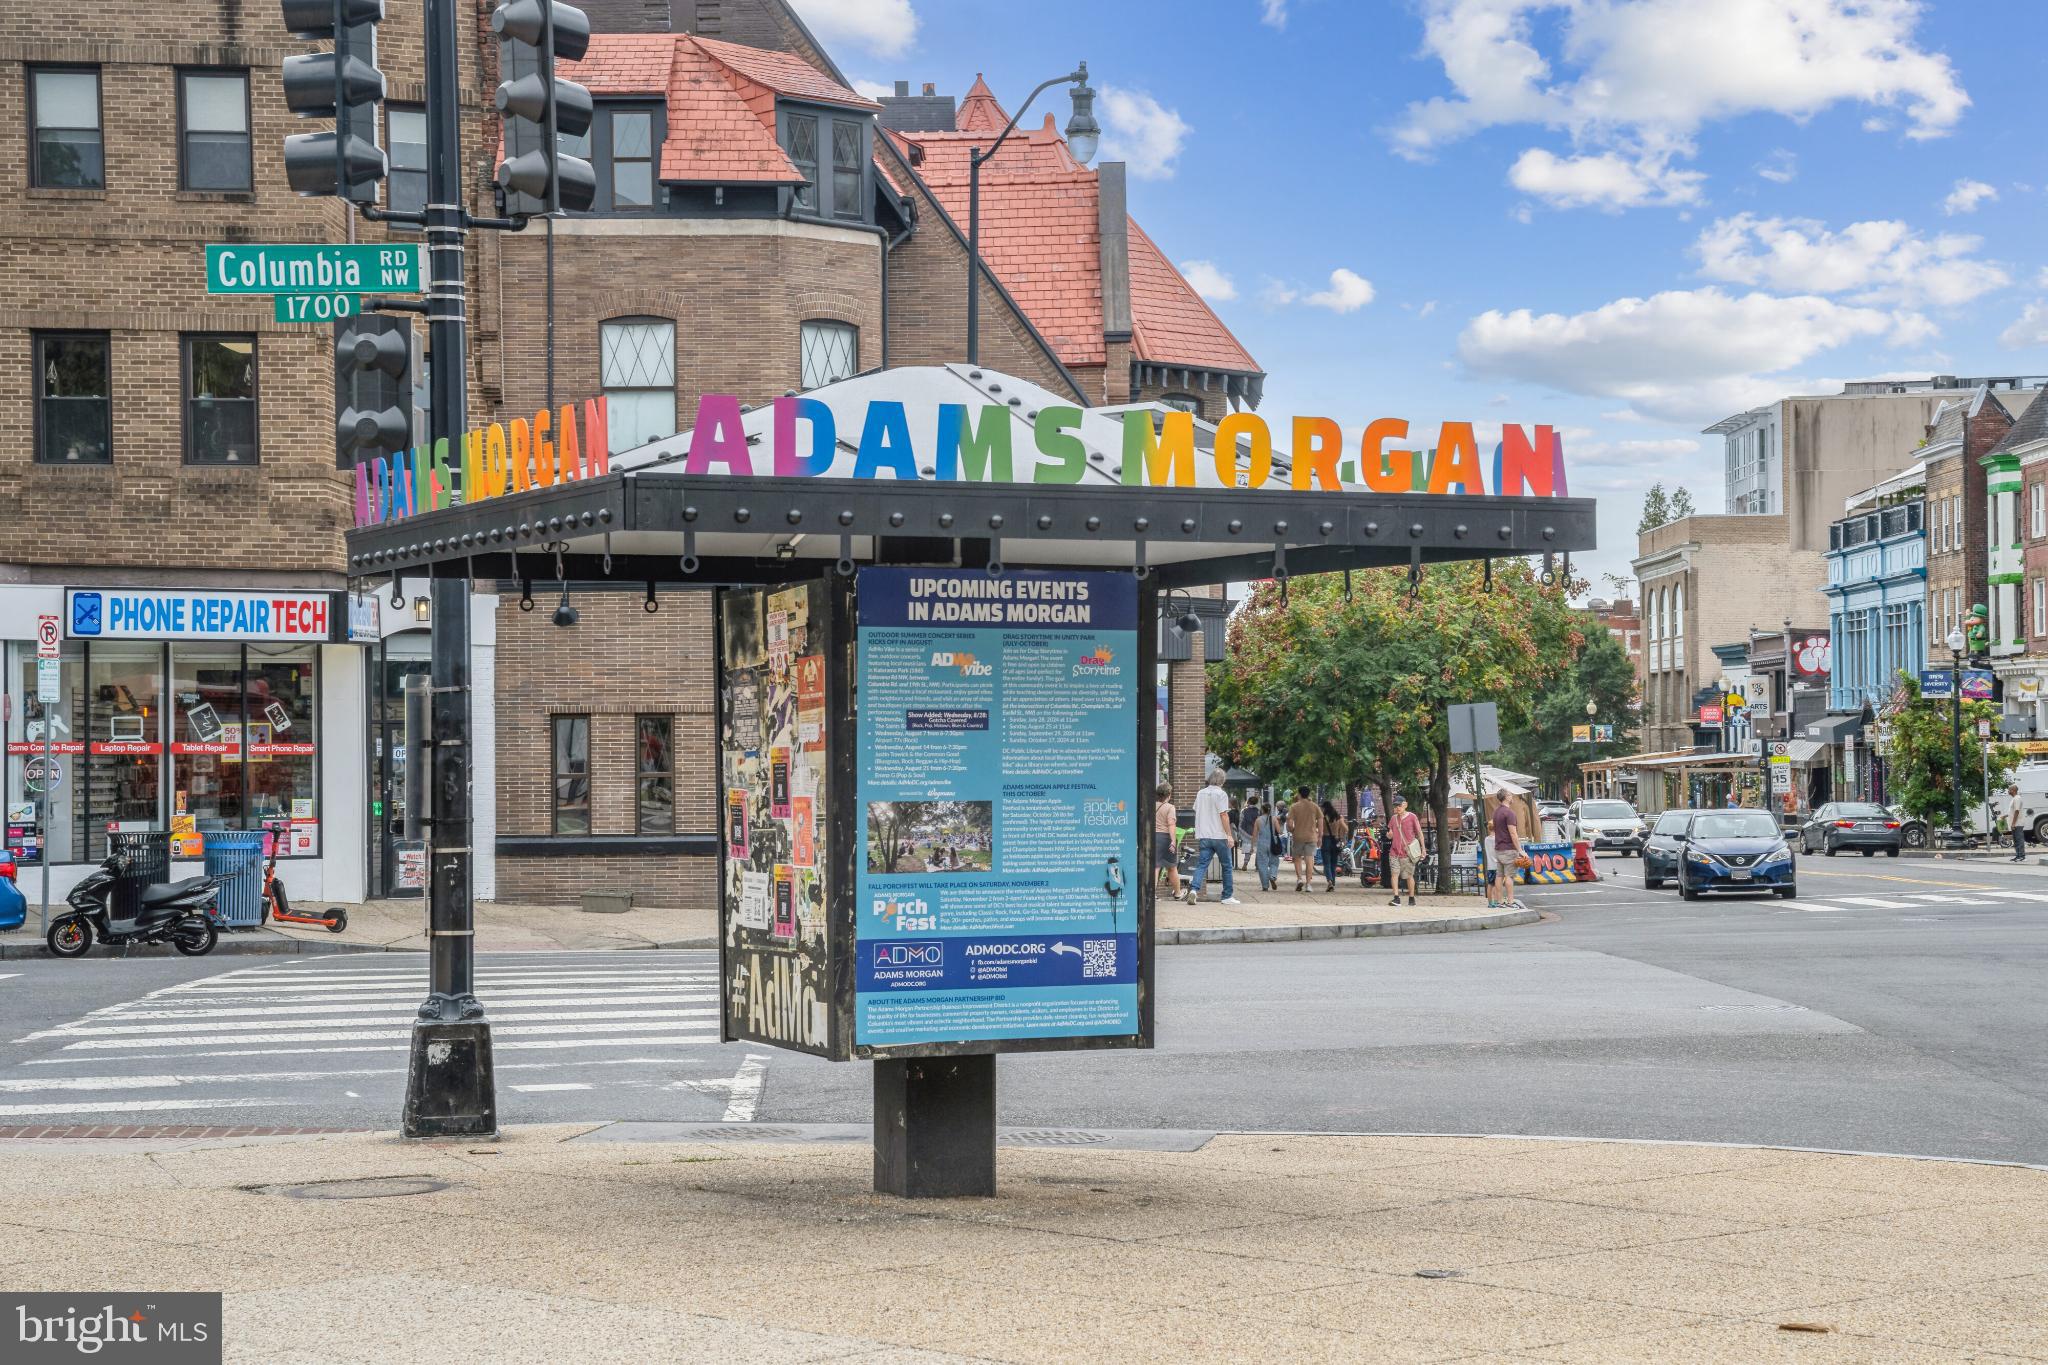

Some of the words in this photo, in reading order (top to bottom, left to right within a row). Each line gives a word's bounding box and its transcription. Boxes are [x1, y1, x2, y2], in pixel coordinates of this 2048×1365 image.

[381, 251, 407, 266] RD
[219, 251, 360, 287] Columbia
[382, 269, 409, 286] NW
[287, 295, 350, 319] 1700
[684, 395, 1082, 485] ADAMS
[1122, 411, 1555, 497] MORGAN
[355, 438, 452, 527] ADAMS
[461, 396, 608, 504] MORGAN
[910, 579, 1013, 599] UPCOMING
[1016, 581, 1088, 601] EVENTS
[110, 598, 185, 632] PHONE
[192, 599, 269, 632] REPAIR
[272, 600, 326, 634] TECH
[908, 602, 926, 621] IN
[929, 602, 1003, 622] ADAMS
[1007, 604, 1090, 623] MORGAN
[963, 661, 992, 676] vibe
[1081, 656, 1104, 666] Drag
[1073, 665, 1120, 678] Storytime
[61, 745, 84, 753] Repair
[100, 745, 126, 753] Laptop
[128, 745, 151, 753] Repair
[205, 744, 228, 753] Repair
[293, 745, 315, 753] Repair
[26, 769, 60, 779] OPN
[1776, 775, 1787, 783] 15
[1084, 797, 1116, 814] apple
[1084, 812, 1128, 825] festival
[1533, 853, 1565, 874] MO
[873, 899, 928, 916] Porch
[896, 915, 936, 931] Fest
[877, 946, 940, 964] ADMO
[965, 944, 1046, 956] ADMODC.ORG
[874, 971, 904, 979] ADAMS
[905, 970, 943, 978] MORGAN
